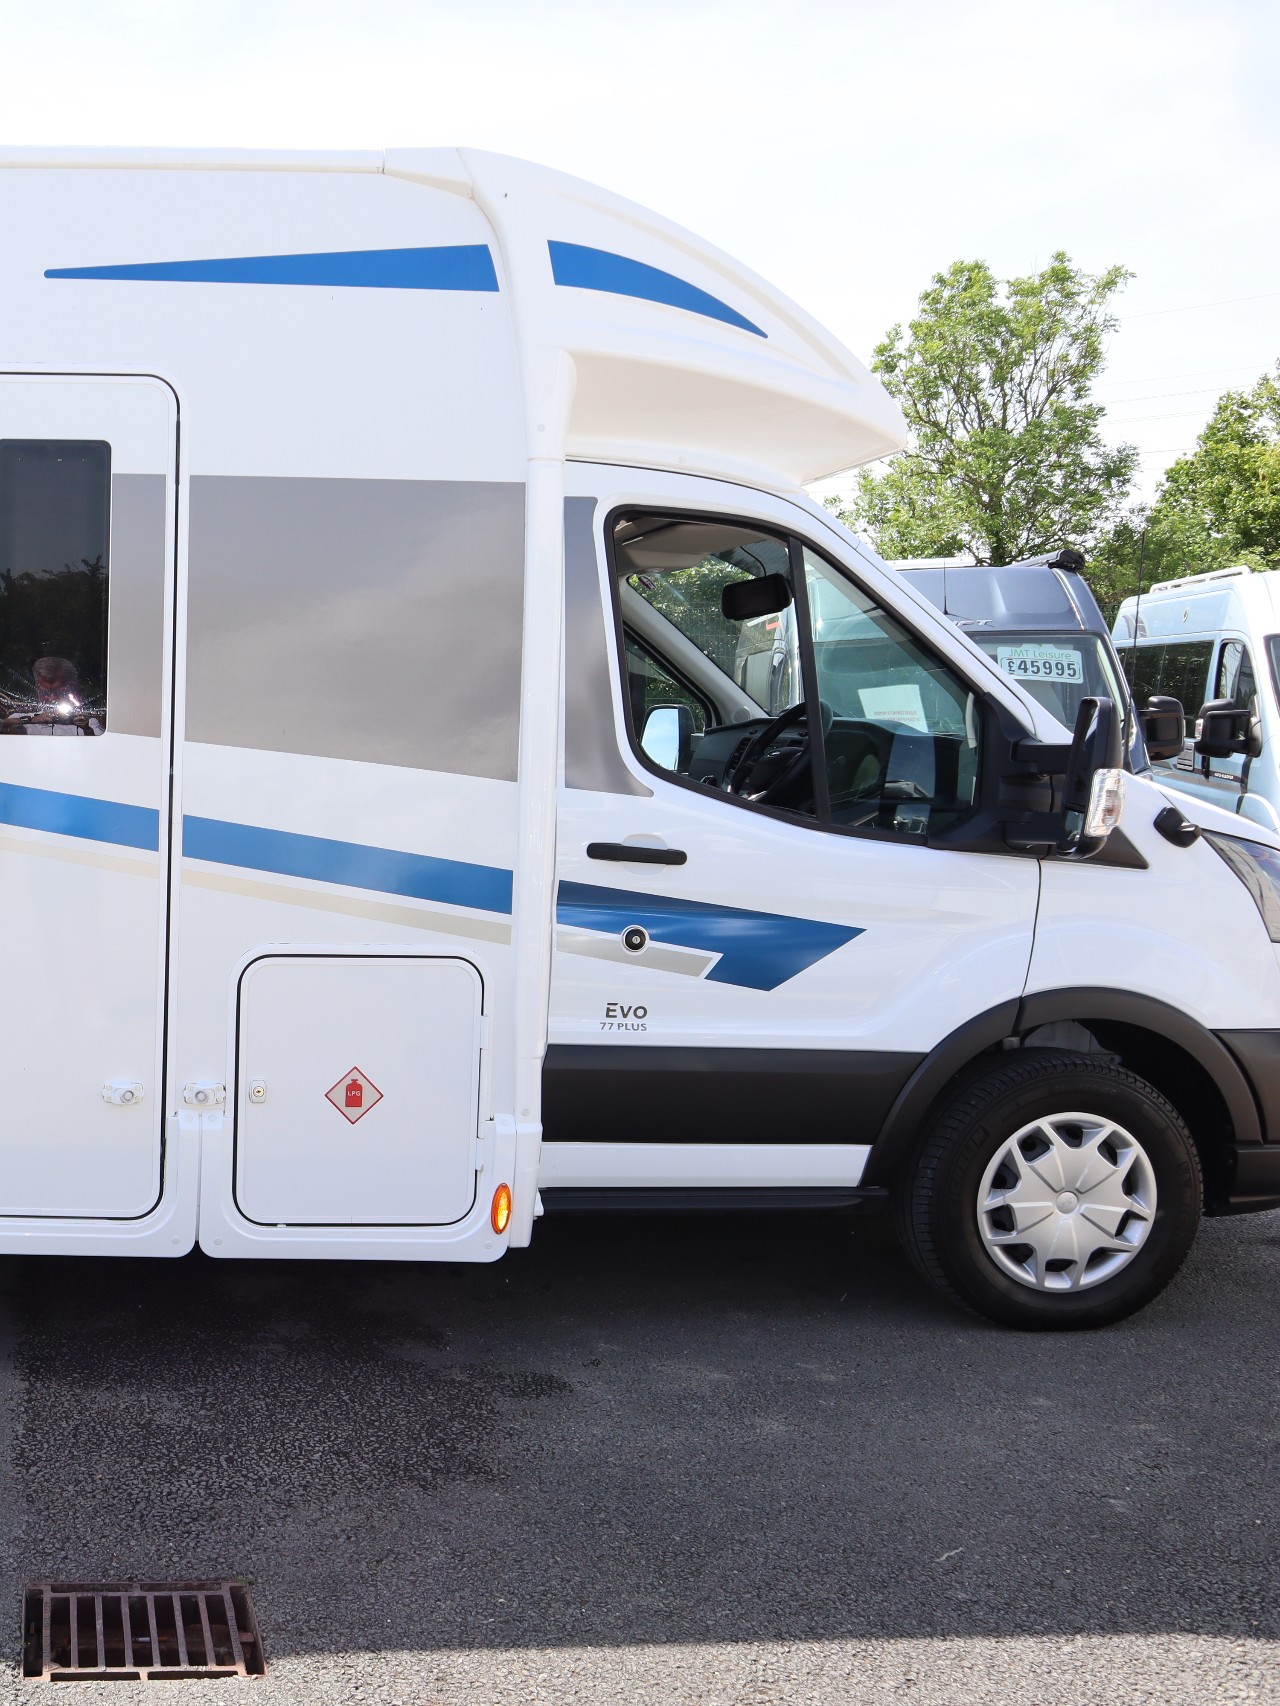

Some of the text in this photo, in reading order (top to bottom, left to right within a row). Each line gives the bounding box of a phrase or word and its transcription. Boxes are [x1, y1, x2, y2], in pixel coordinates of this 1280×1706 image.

[1009, 649, 1072, 659] JMT Leisure
[1008, 660, 1077, 678] £45995
[605, 1002, 648, 1019] EVO
[600, 1022, 647, 1031] 77 PLUS
